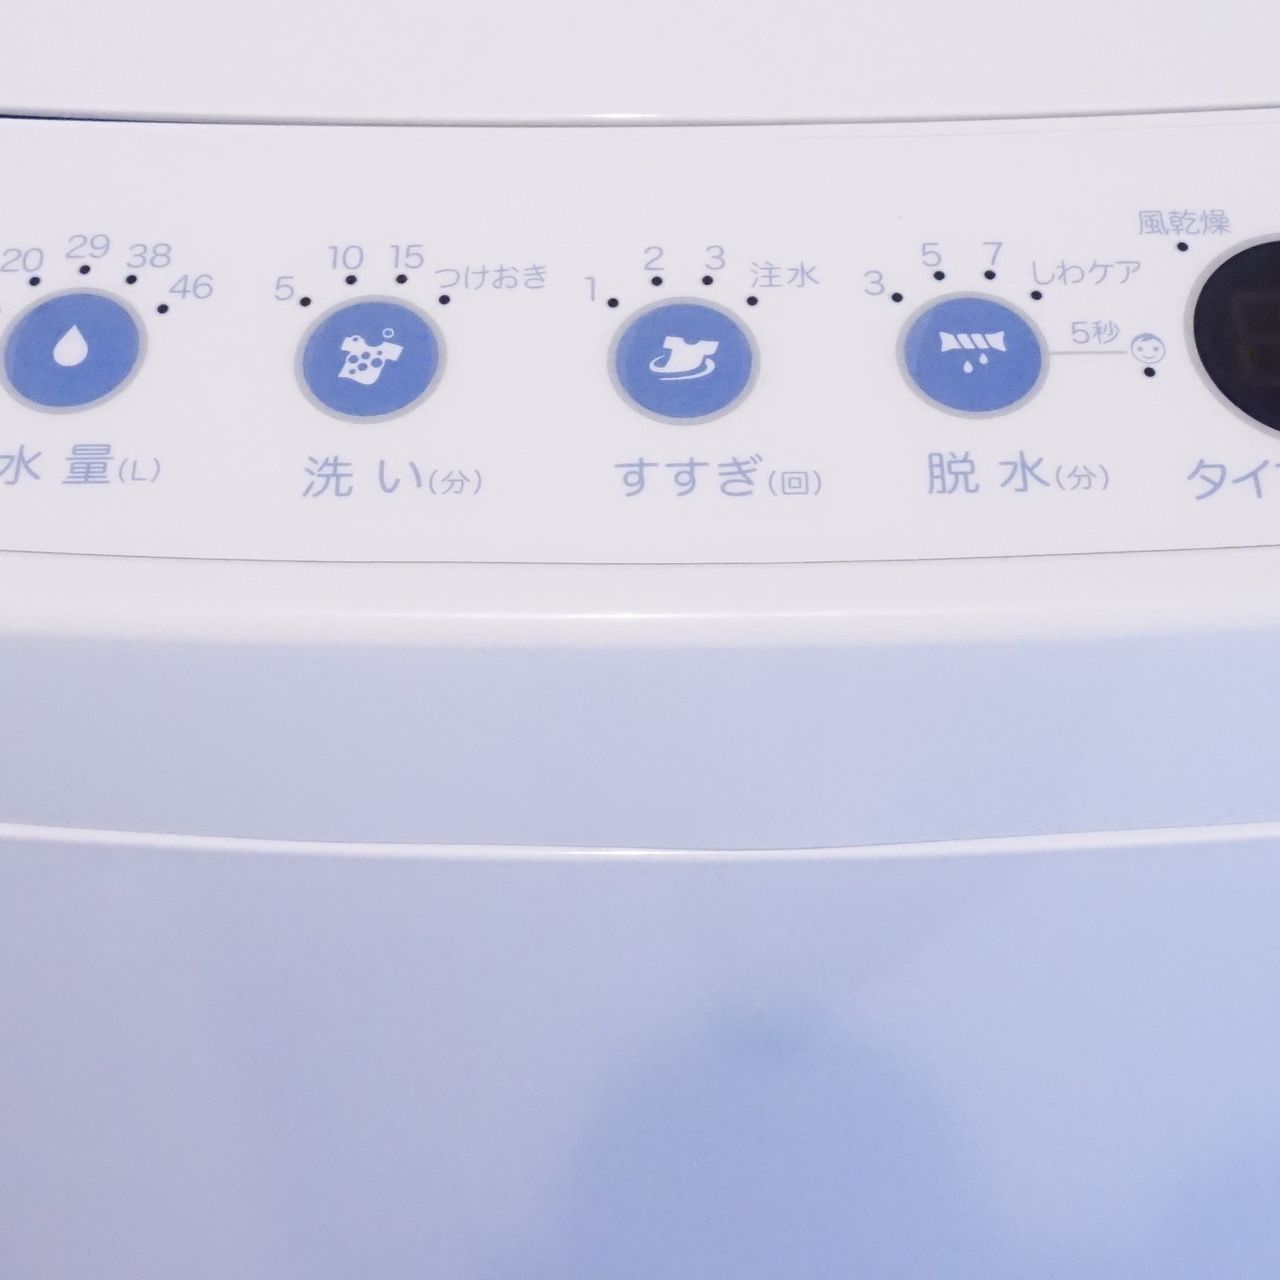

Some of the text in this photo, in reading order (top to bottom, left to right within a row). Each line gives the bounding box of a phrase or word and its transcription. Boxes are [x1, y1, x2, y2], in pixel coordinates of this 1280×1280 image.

[1139, 209, 1232, 236] 風乾燥
[65, 234, 110, 259] 29
[126, 243, 171, 269] 38
[328, 245, 364, 270] 10
[390, 244, 424, 269] 15
[644, 247, 664, 271] 2
[705, 245, 725, 270] 3
[922, 243, 942, 266] 5
[984, 241, 1003, 266] 7
[0, 248, 44, 272] 20
[1032, 260, 1141, 285] しわケア
[170, 274, 213, 299] 46
[434, 264, 547, 290] つけおき
[750, 261, 819, 287] 注水
[864, 270, 885, 295] 3
[275, 276, 294, 301] 5
[585, 277, 595, 301] 1
[1071, 320, 1120, 344] 5秒
